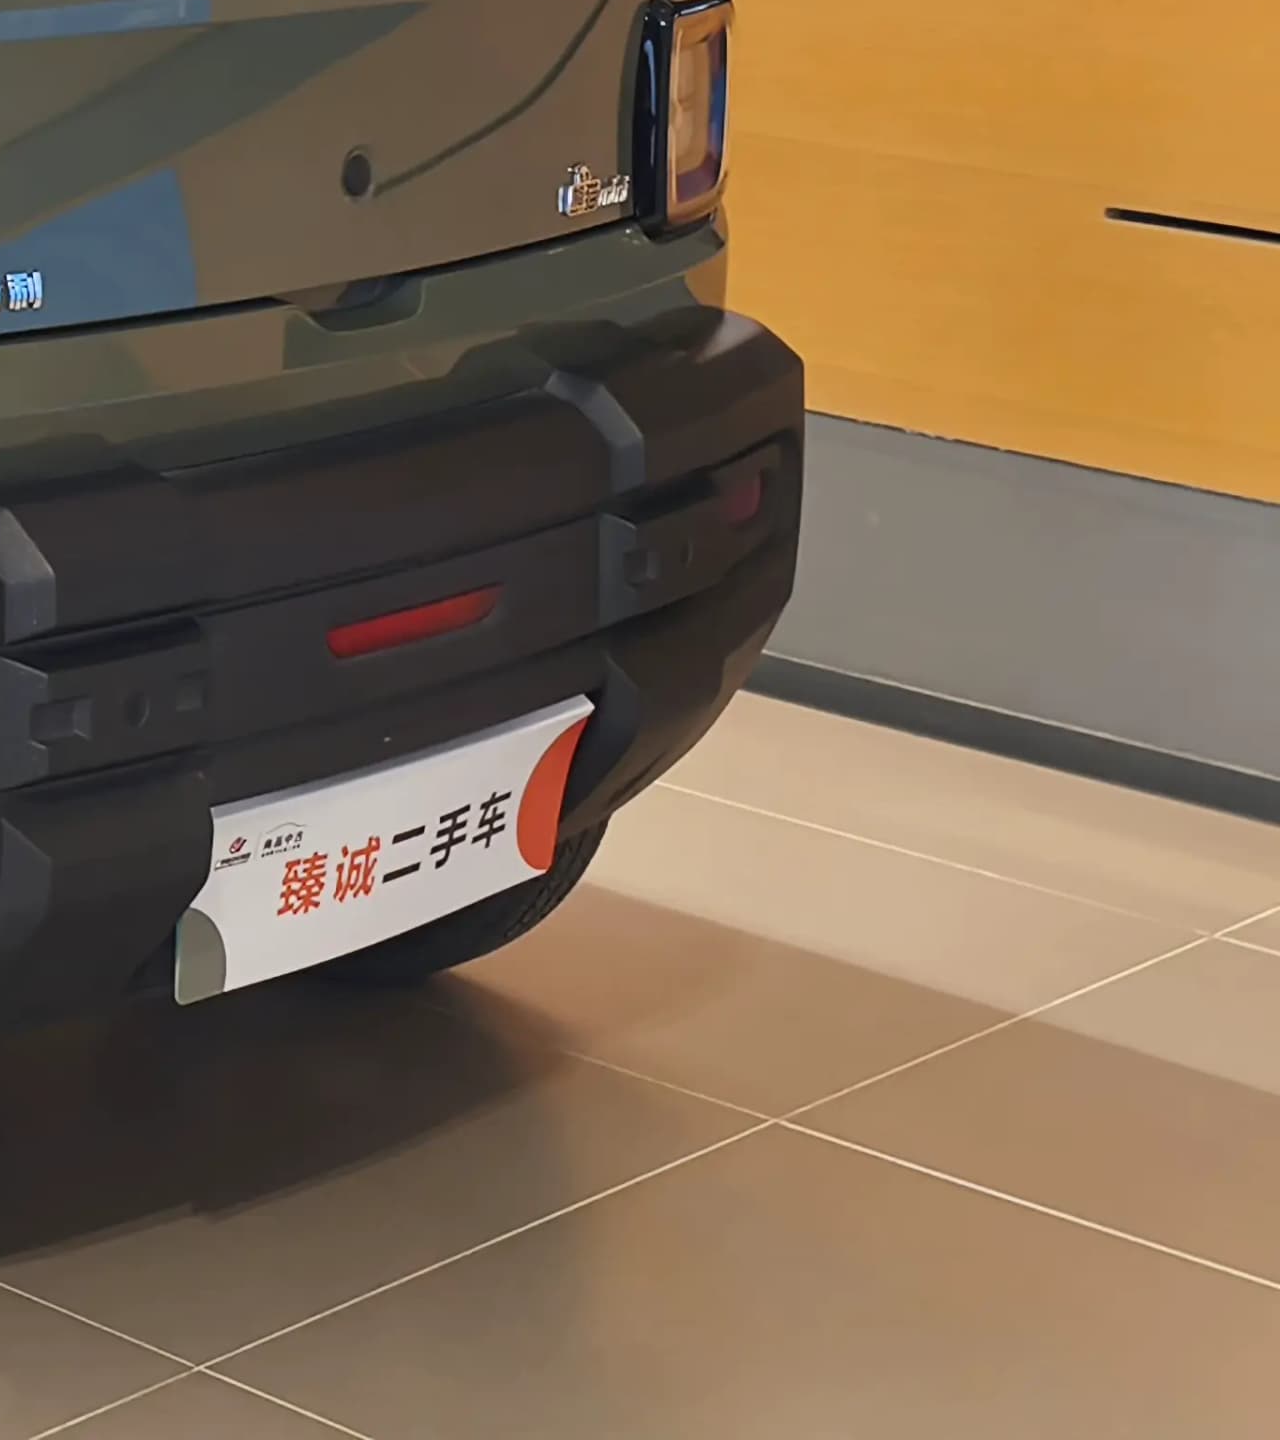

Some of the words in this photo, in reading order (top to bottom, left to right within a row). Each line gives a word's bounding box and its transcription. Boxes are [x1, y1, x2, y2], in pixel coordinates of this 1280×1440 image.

[277, 791, 512, 915] 臻诚二手车
